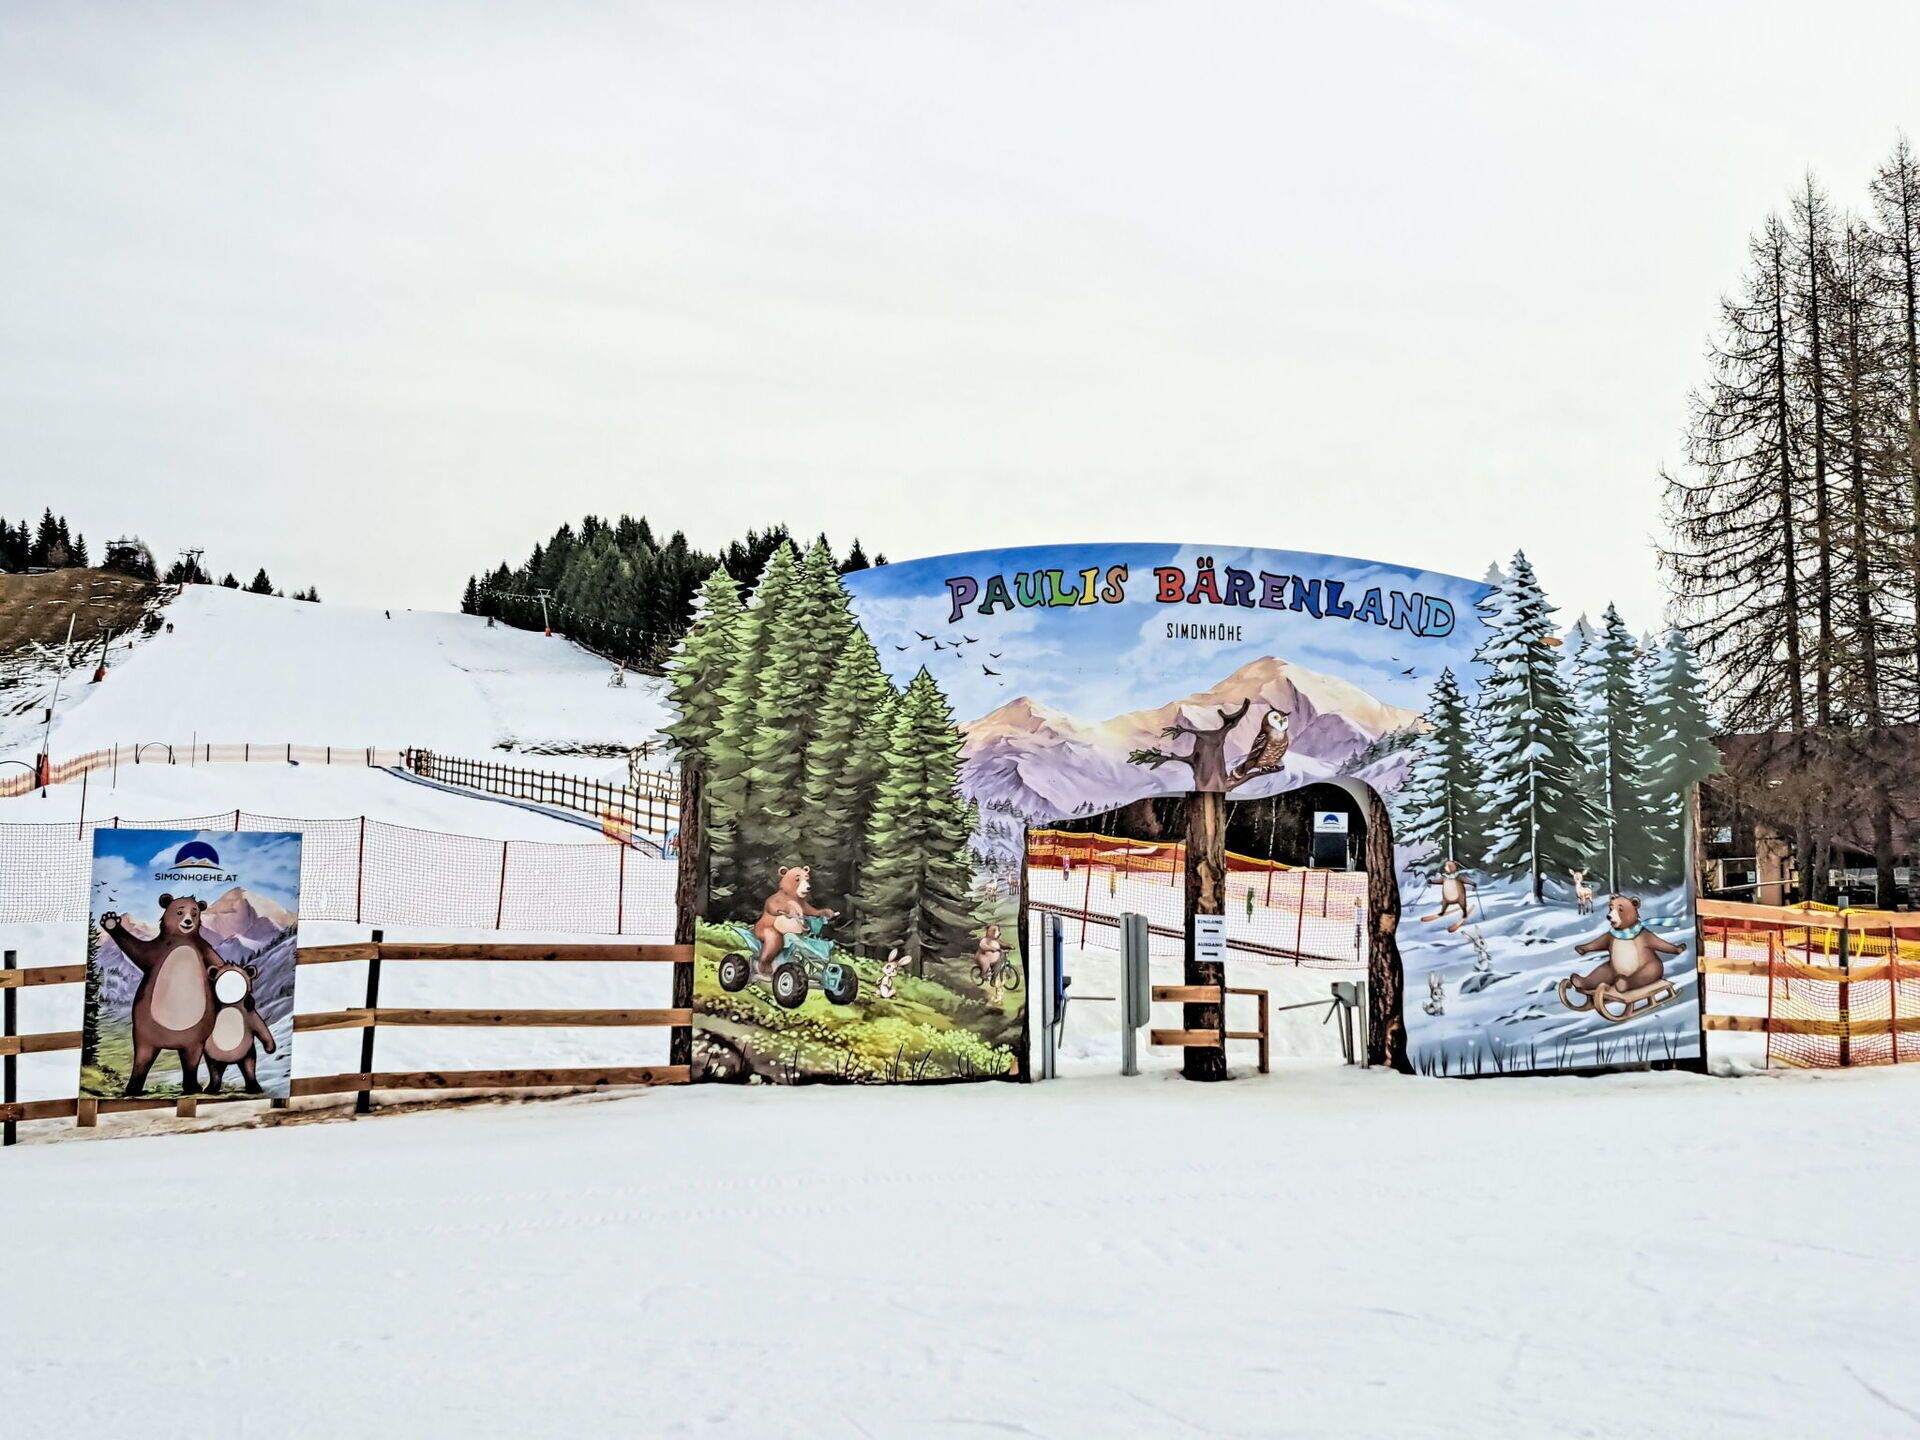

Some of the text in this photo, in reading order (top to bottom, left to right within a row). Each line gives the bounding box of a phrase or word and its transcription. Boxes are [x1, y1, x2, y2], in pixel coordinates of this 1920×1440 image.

[945, 556, 1456, 638] PAULIS BÄRENLAND
[1166, 622, 1243, 642] SIMONHÖHE
[154, 872, 239, 882] SIMONHOEHE.AT
